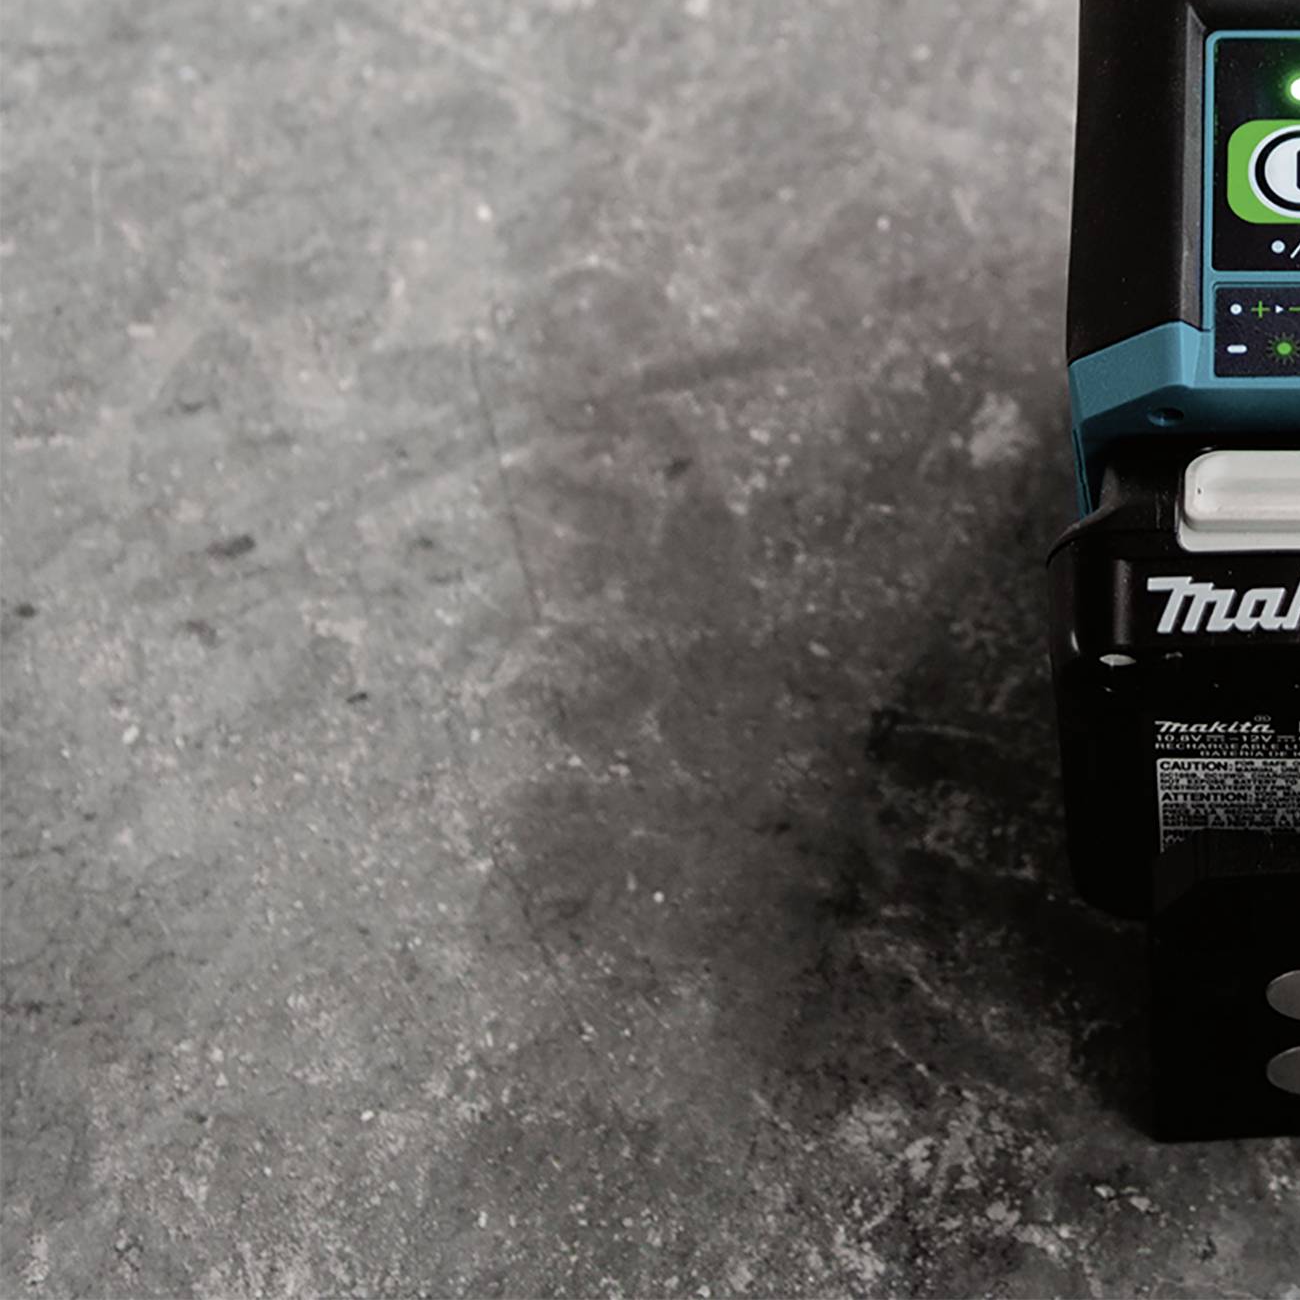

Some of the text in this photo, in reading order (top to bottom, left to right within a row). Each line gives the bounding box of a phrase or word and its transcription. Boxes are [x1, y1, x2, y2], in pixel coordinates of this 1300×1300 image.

[1156, 734, 1202, 743] 10.8V
[1242, 734, 1272, 743] 12V
[1160, 761, 1233, 771] CAUTION:
